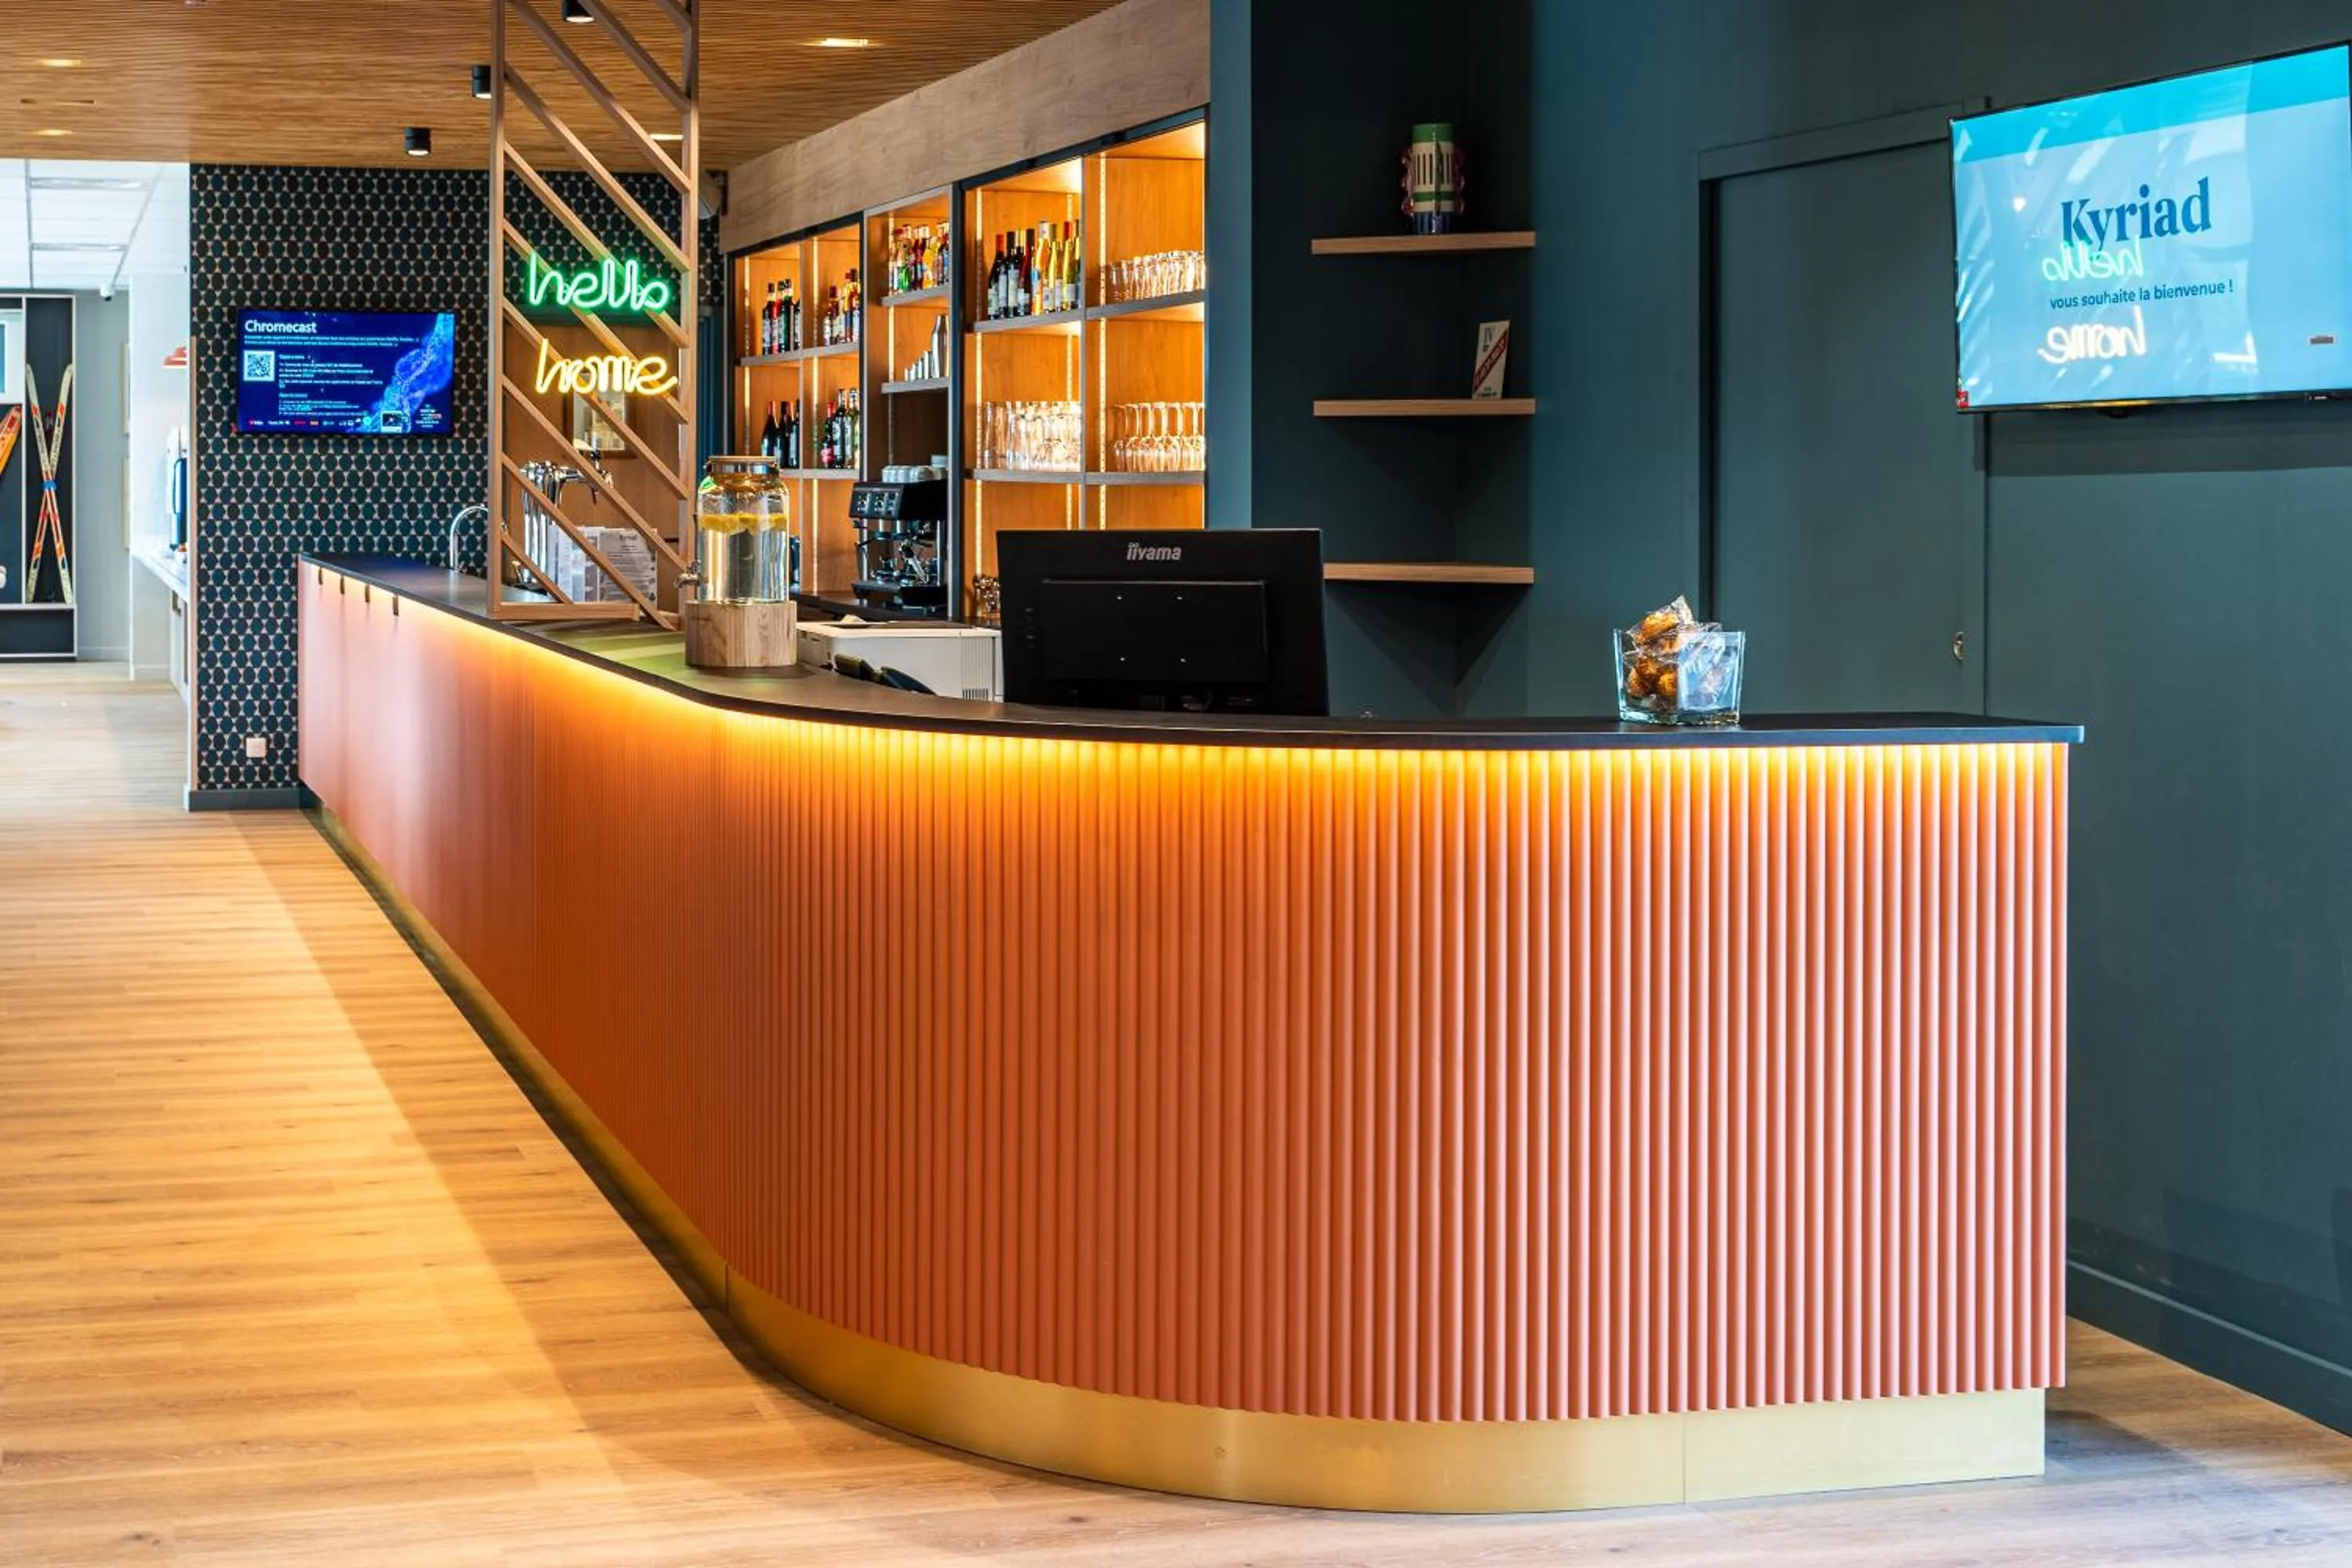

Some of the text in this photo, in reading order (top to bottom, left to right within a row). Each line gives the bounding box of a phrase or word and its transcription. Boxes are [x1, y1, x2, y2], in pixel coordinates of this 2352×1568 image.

[2060, 176, 2212, 260] Kyriad
[528, 250, 670, 310] hello
[2049, 296, 2078, 310] vous
[2082, 289, 2136, 307] souhaite
[2139, 288, 2151, 301] la
[2154, 283, 2226, 300] bienvenue
[244, 318, 318, 333] Chromecast
[535, 338, 679, 395] home
[1127, 542, 1182, 561] iiyama
